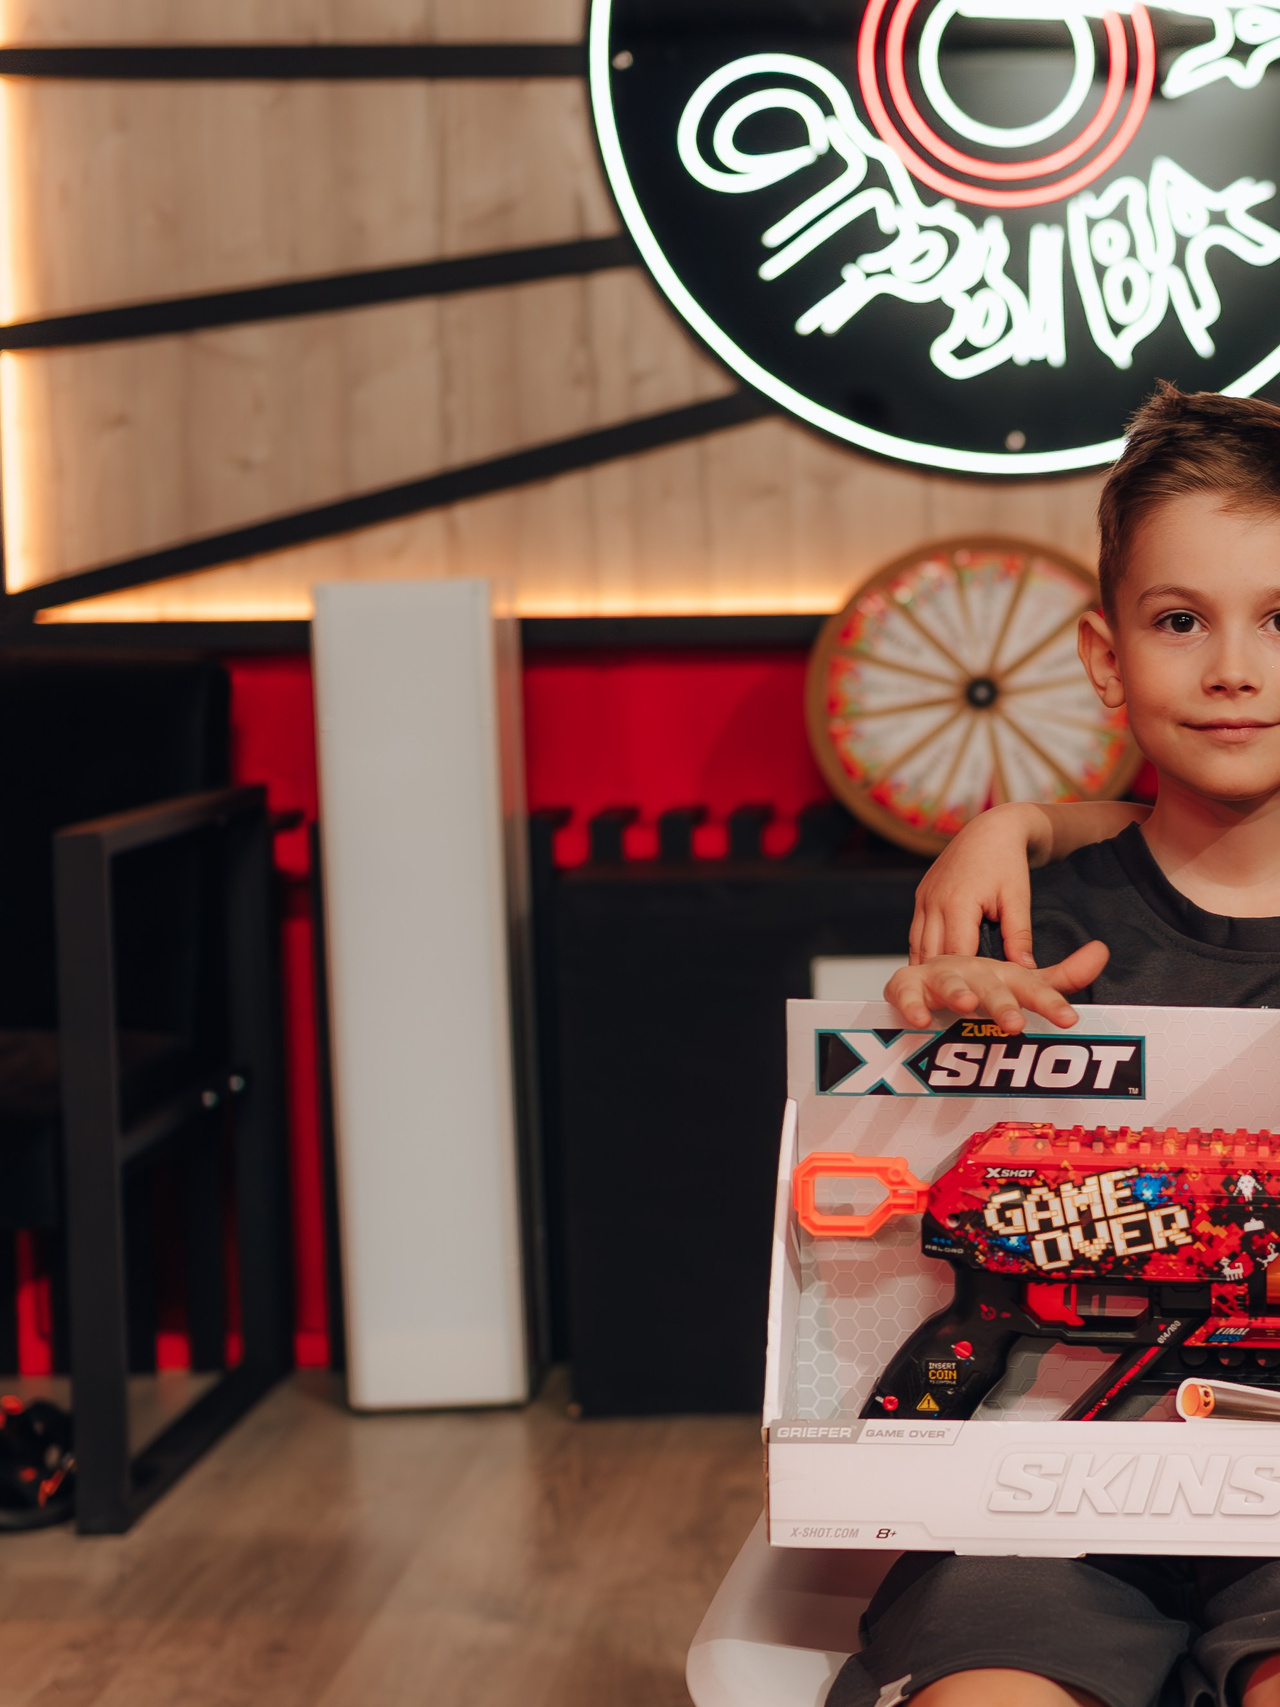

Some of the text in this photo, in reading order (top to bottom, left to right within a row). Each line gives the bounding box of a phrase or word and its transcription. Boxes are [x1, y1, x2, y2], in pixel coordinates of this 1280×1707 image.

[984, 1167, 1145, 1235] GAME
[1031, 1205, 1193, 1270] OVER
[1215, 1327, 1250, 1335] FINAL
[928, 1362, 957, 1370] INSERT
[928, 1370, 957, 1380] COIN
[776, 1426, 852, 1438] GRIEFER
[865, 1429, 946, 1438] GAME OVER
[790, 1527, 860, 1538] X-SHOT.COM
[876, 1528, 897, 1539] 8+
